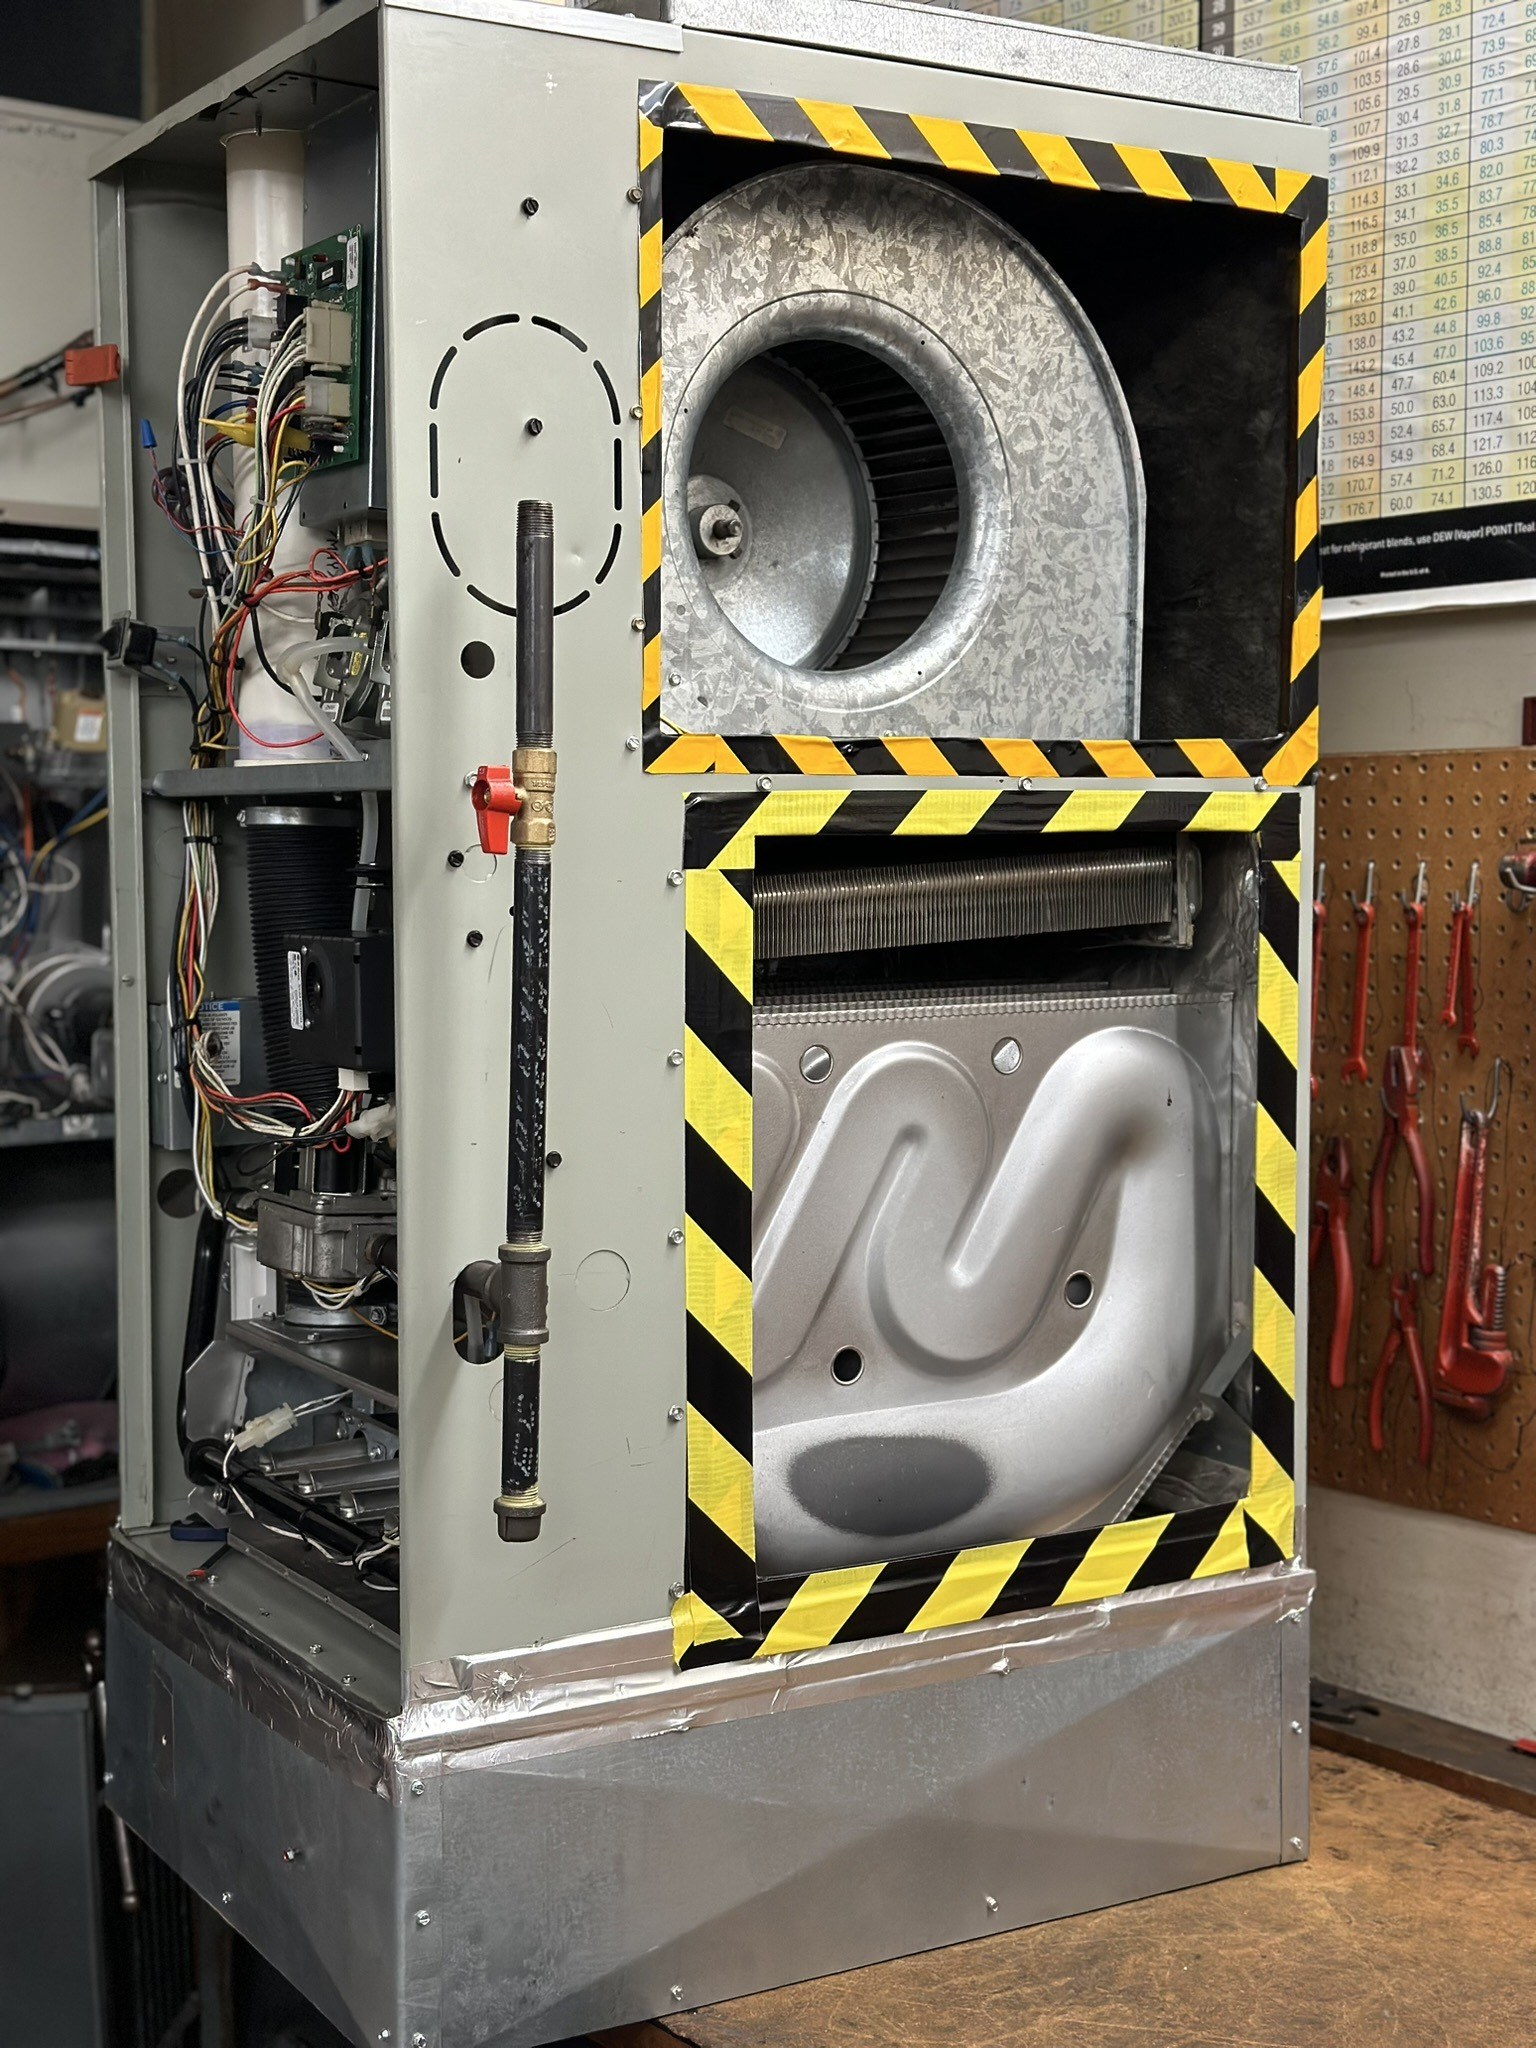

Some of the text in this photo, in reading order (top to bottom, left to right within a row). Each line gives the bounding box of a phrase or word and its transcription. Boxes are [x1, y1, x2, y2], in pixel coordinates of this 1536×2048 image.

[1212, 21, 1226, 37] 29
[1243, 10, 1263, 28] 53.7
[1243, 34, 1263, 51] 55.0
[1280, 21, 1300, 37] 49.6
[1356, 1, 1379, 16] 97.4
[1357, 24, 1378, 40] 99.4
[1398, 11, 1420, 29] 26.9
[1439, 1, 1462, 17] 28.3
[1317, 58, 1338, 75] 57.6
[1353, 46, 1381, 65] 101.4
[1397, 35, 1420, 53] 27.8
[1439, 24, 1460, 41] 29.1
[1482, 11, 1505, 29] 72.4
[1317, 82, 1338, 99] 59.0
[1353, 71, 1381, 89] 103.5
[1397, 60, 1420, 77] 28.6
[1439, 48, 1462, 66] 30.0
[1482, 37, 1505, 55] 73.9
[1316, 106, 1337, 123] 60.4
[1353, 95, 1381, 113] 105.6
[1397, 84, 1420, 101] 29.5
[1438, 73, 1462, 91] 30.9
[1482, 62, 1505, 79] 75.5
[1352, 119, 1380, 137] 107.7
[1397, 108, 1419, 126] 30.4
[1438, 98, 1461, 116] 31.8
[1481, 87, 1504, 104] 77.1
[1352, 142, 1380, 162] 109.9
[1396, 133, 1419, 151] 31.3
[1437, 122, 1460, 140] 32.7
[1481, 113, 1504, 129] 78.7
[1352, 167, 1379, 185] 112.1
[1396, 157, 1418, 175] 32.2
[1437, 147, 1459, 165] 33.6
[1480, 137, 1504, 154] 80.3
[1351, 191, 1379, 209] 114.3
[1395, 182, 1417, 199] 33.1
[1436, 172, 1459, 189] 34.6
[1480, 162, 1504, 179] 82.0
[1351, 216, 1378, 234] 116.5
[1394, 207, 1416, 223] 34.1
[1436, 196, 1459, 214] 35.5
[1479, 187, 1503, 204] 83.7
[1350, 239, 1377, 257] 118.8
[1394, 230, 1417, 247] 35.0
[1435, 222, 1459, 238] 36.5
[1478, 212, 1502, 229] 85.4
[1349, 263, 1377, 281] 123.4
[1393, 255, 1416, 272] 37.0
[1435, 246, 1458, 263] 38.5
[1478, 237, 1502, 255] 88.8
[1349, 287, 1377, 304] 128.2
[1393, 279, 1416, 296] 39.0
[1434, 271, 1458, 287] 40.5
[1478, 262, 1501, 279] 92.4
[1348, 311, 1376, 328] 133.0
[1392, 303, 1414, 319] 41.1
[1433, 295, 1457, 311] 42.6
[1477, 286, 1501, 304] 96.0
[1348, 334, 1376, 350] 138.0
[1392, 328, 1415, 342] 43.2
[1433, 320, 1457, 335] 44.8
[1476, 311, 1500, 328] 99.8
[1348, 358, 1375, 374] 143.2
[1392, 351, 1414, 367] 45.4
[1433, 344, 1457, 360] 47.0
[1474, 336, 1504, 353] 103.6
[1348, 382, 1375, 399] 148.4
[1391, 376, 1414, 391] 47.7
[1433, 368, 1456, 384] 60.4
[1474, 361, 1504, 377] 109.2
[1347, 406, 1374, 422] 153.8
[1391, 400, 1414, 415] 50.0
[1433, 393, 1456, 409] 63.0
[1473, 385, 1503, 402] 113.3
[1347, 430, 1374, 446] 159.3
[1390, 423, 1412, 439] 52.4
[1432, 417, 1455, 433] 65.7
[1473, 410, 1503, 427] 117.4
[1347, 453, 1374, 469] 164.9
[1391, 447, 1413, 463] 54.9
[1432, 443, 1455, 457] 68.4
[1473, 436, 1502, 452] 121.7
[1347, 477, 1374, 492] 170.7
[1390, 472, 1412, 487] 57.4
[1432, 466, 1455, 482] 71.2
[1472, 459, 1502, 476] 126.0
[1346, 500, 1374, 516] 176.7
[1390, 496, 1412, 511] 60.0
[1432, 491, 1453, 506] 74.1
[1472, 484, 1502, 501] 130.5
[1331, 542, 1342, 554] for
[1343, 538, 1385, 553] refrigerant
[1386, 536, 1415, 547] blends,
[1416, 535, 1431, 544] use
[1433, 530, 1452, 544] DEW
[1485, 523, 1513, 536] POINT
[199, 1002, 224, 1011] OTICE
